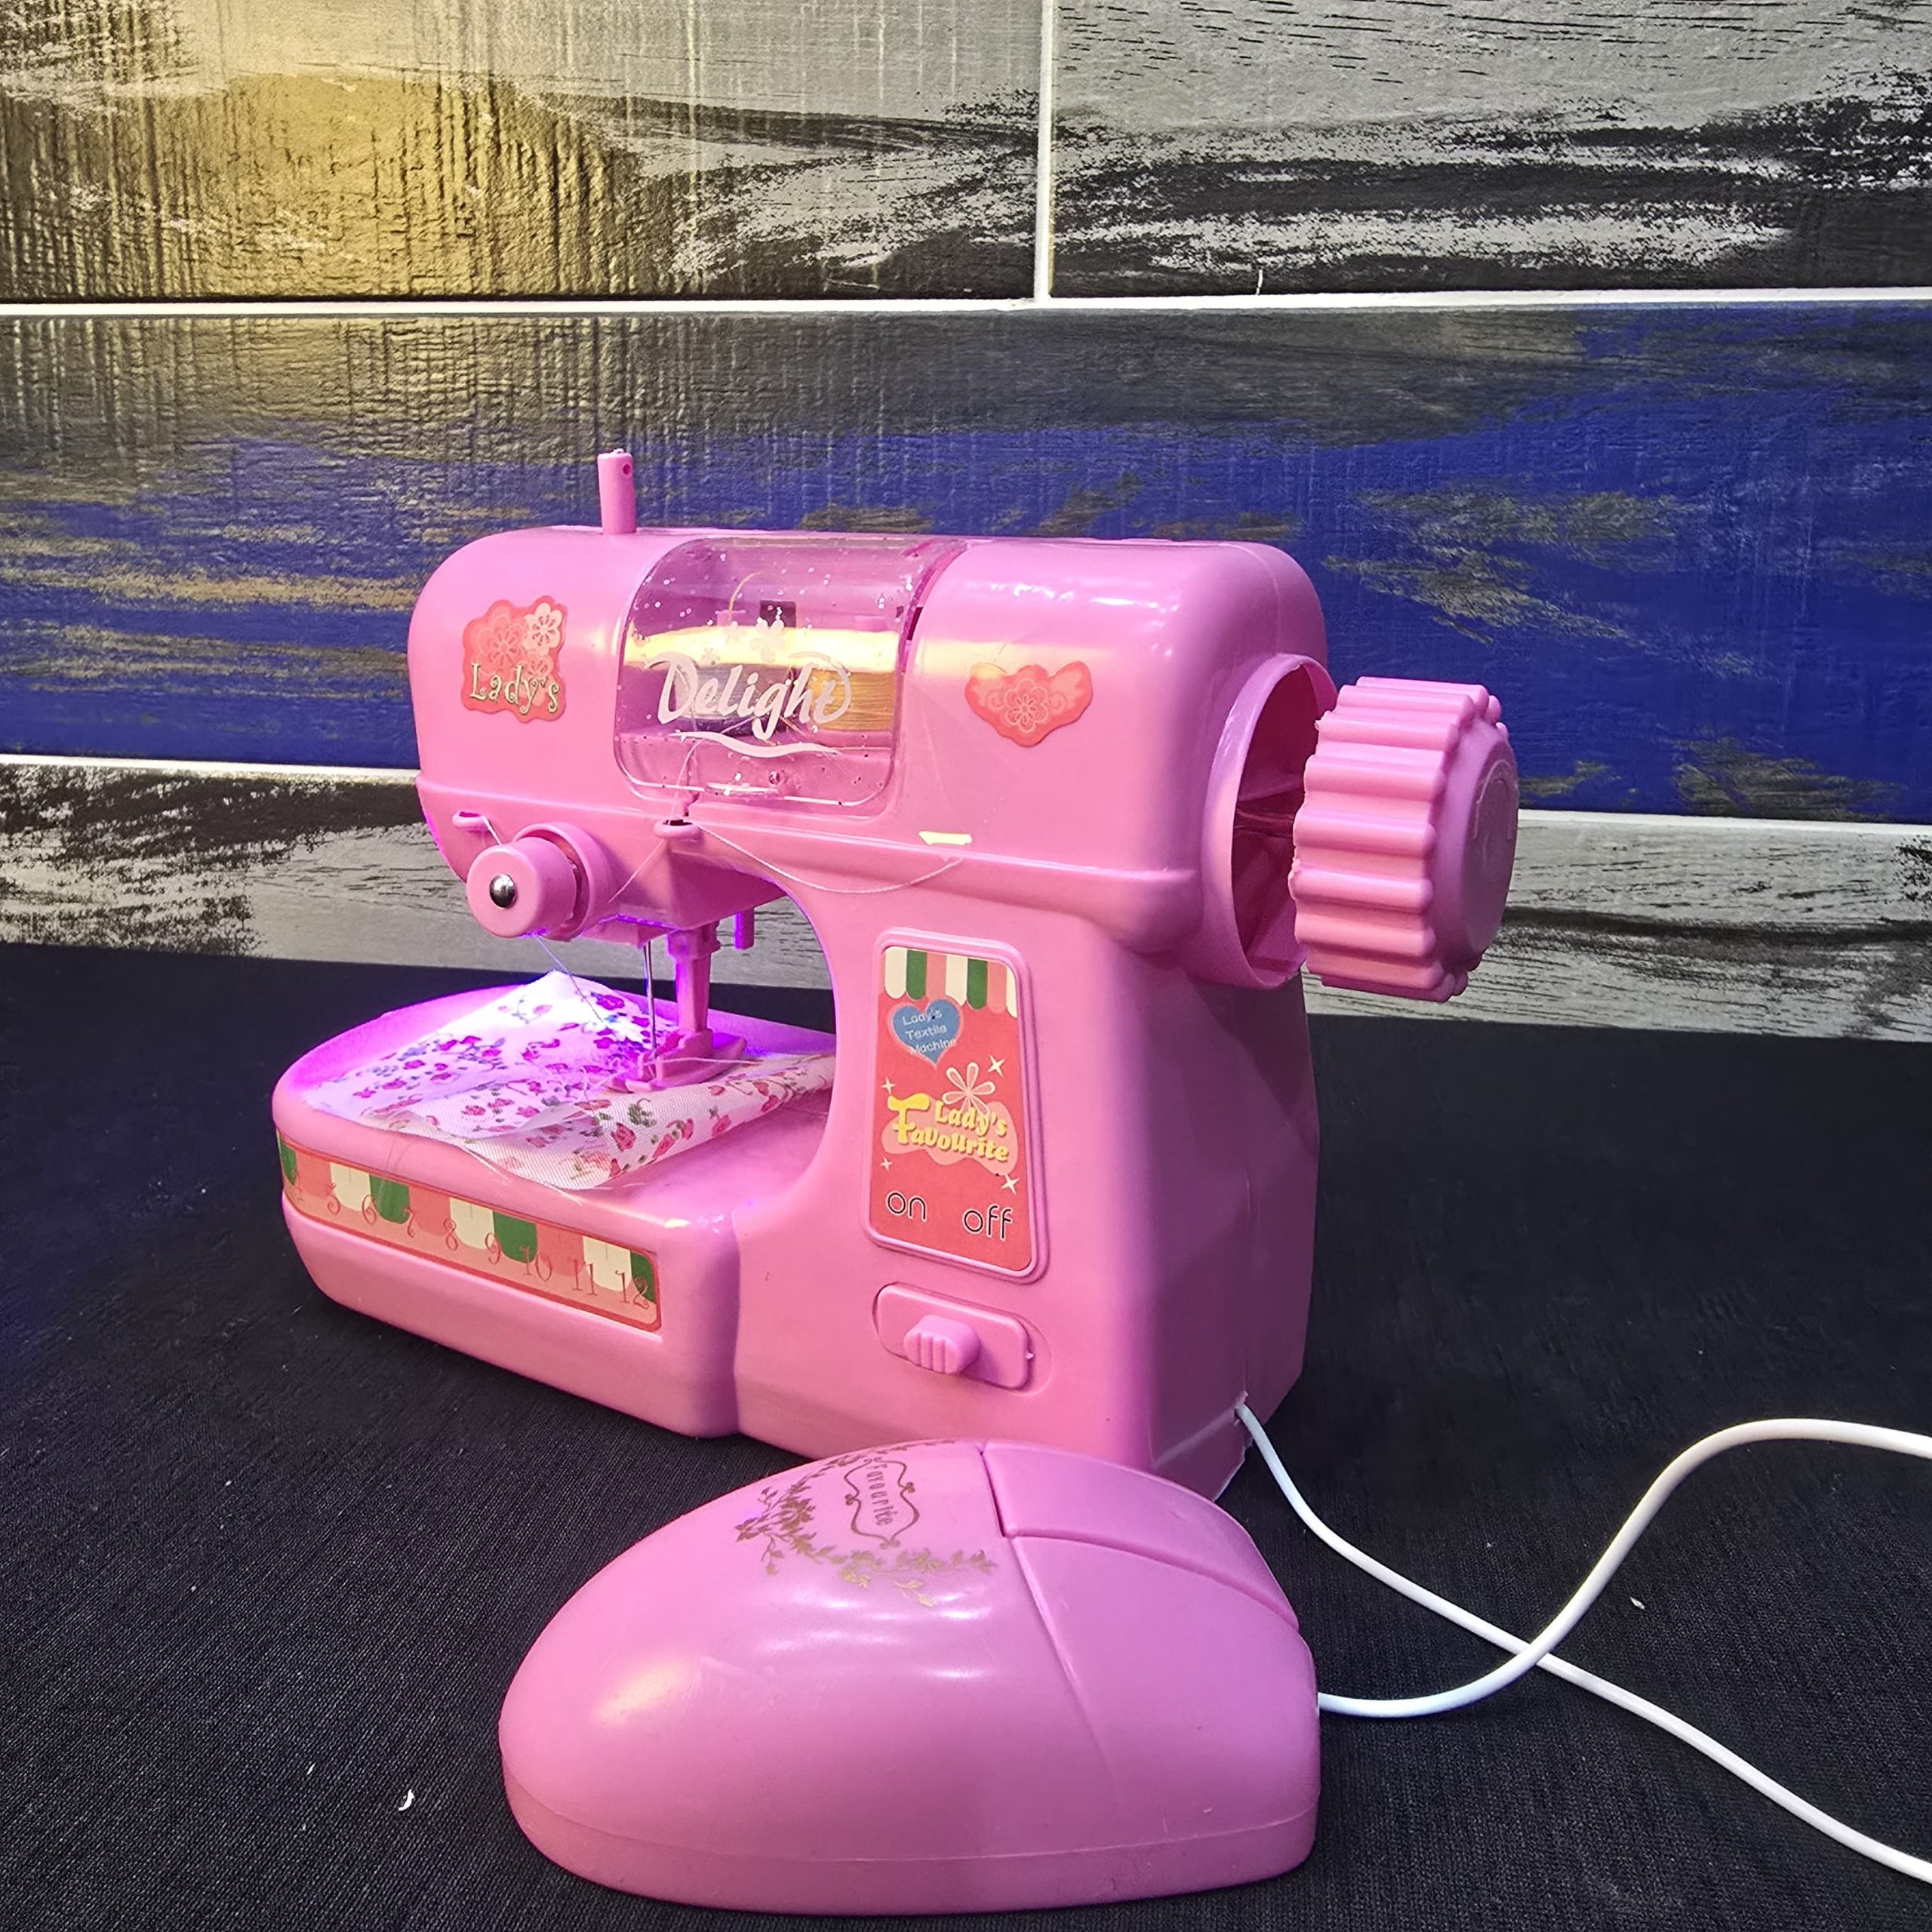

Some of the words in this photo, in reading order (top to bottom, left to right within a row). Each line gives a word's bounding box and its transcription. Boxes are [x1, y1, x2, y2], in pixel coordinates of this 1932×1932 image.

[469, 660, 561, 715] Lady's
[644, 651, 853, 740] Delight
[902, 1008, 943, 1026] Lady's
[905, 1024, 947, 1040] Textile
[888, 1093, 1010, 1162] Favourite
[935, 1100, 1008, 1137] Lady's
[888, 1192, 927, 1221] on
[963, 1205, 1012, 1239] off
[361, 1194, 377, 1226] 6
[443, 1218, 459, 1251] 8
[485, 1232, 502, 1265] 9
[520, 1245, 552, 1282] 10
[569, 1259, 598, 1296] 11
[615, 1269, 651, 1310] 12
